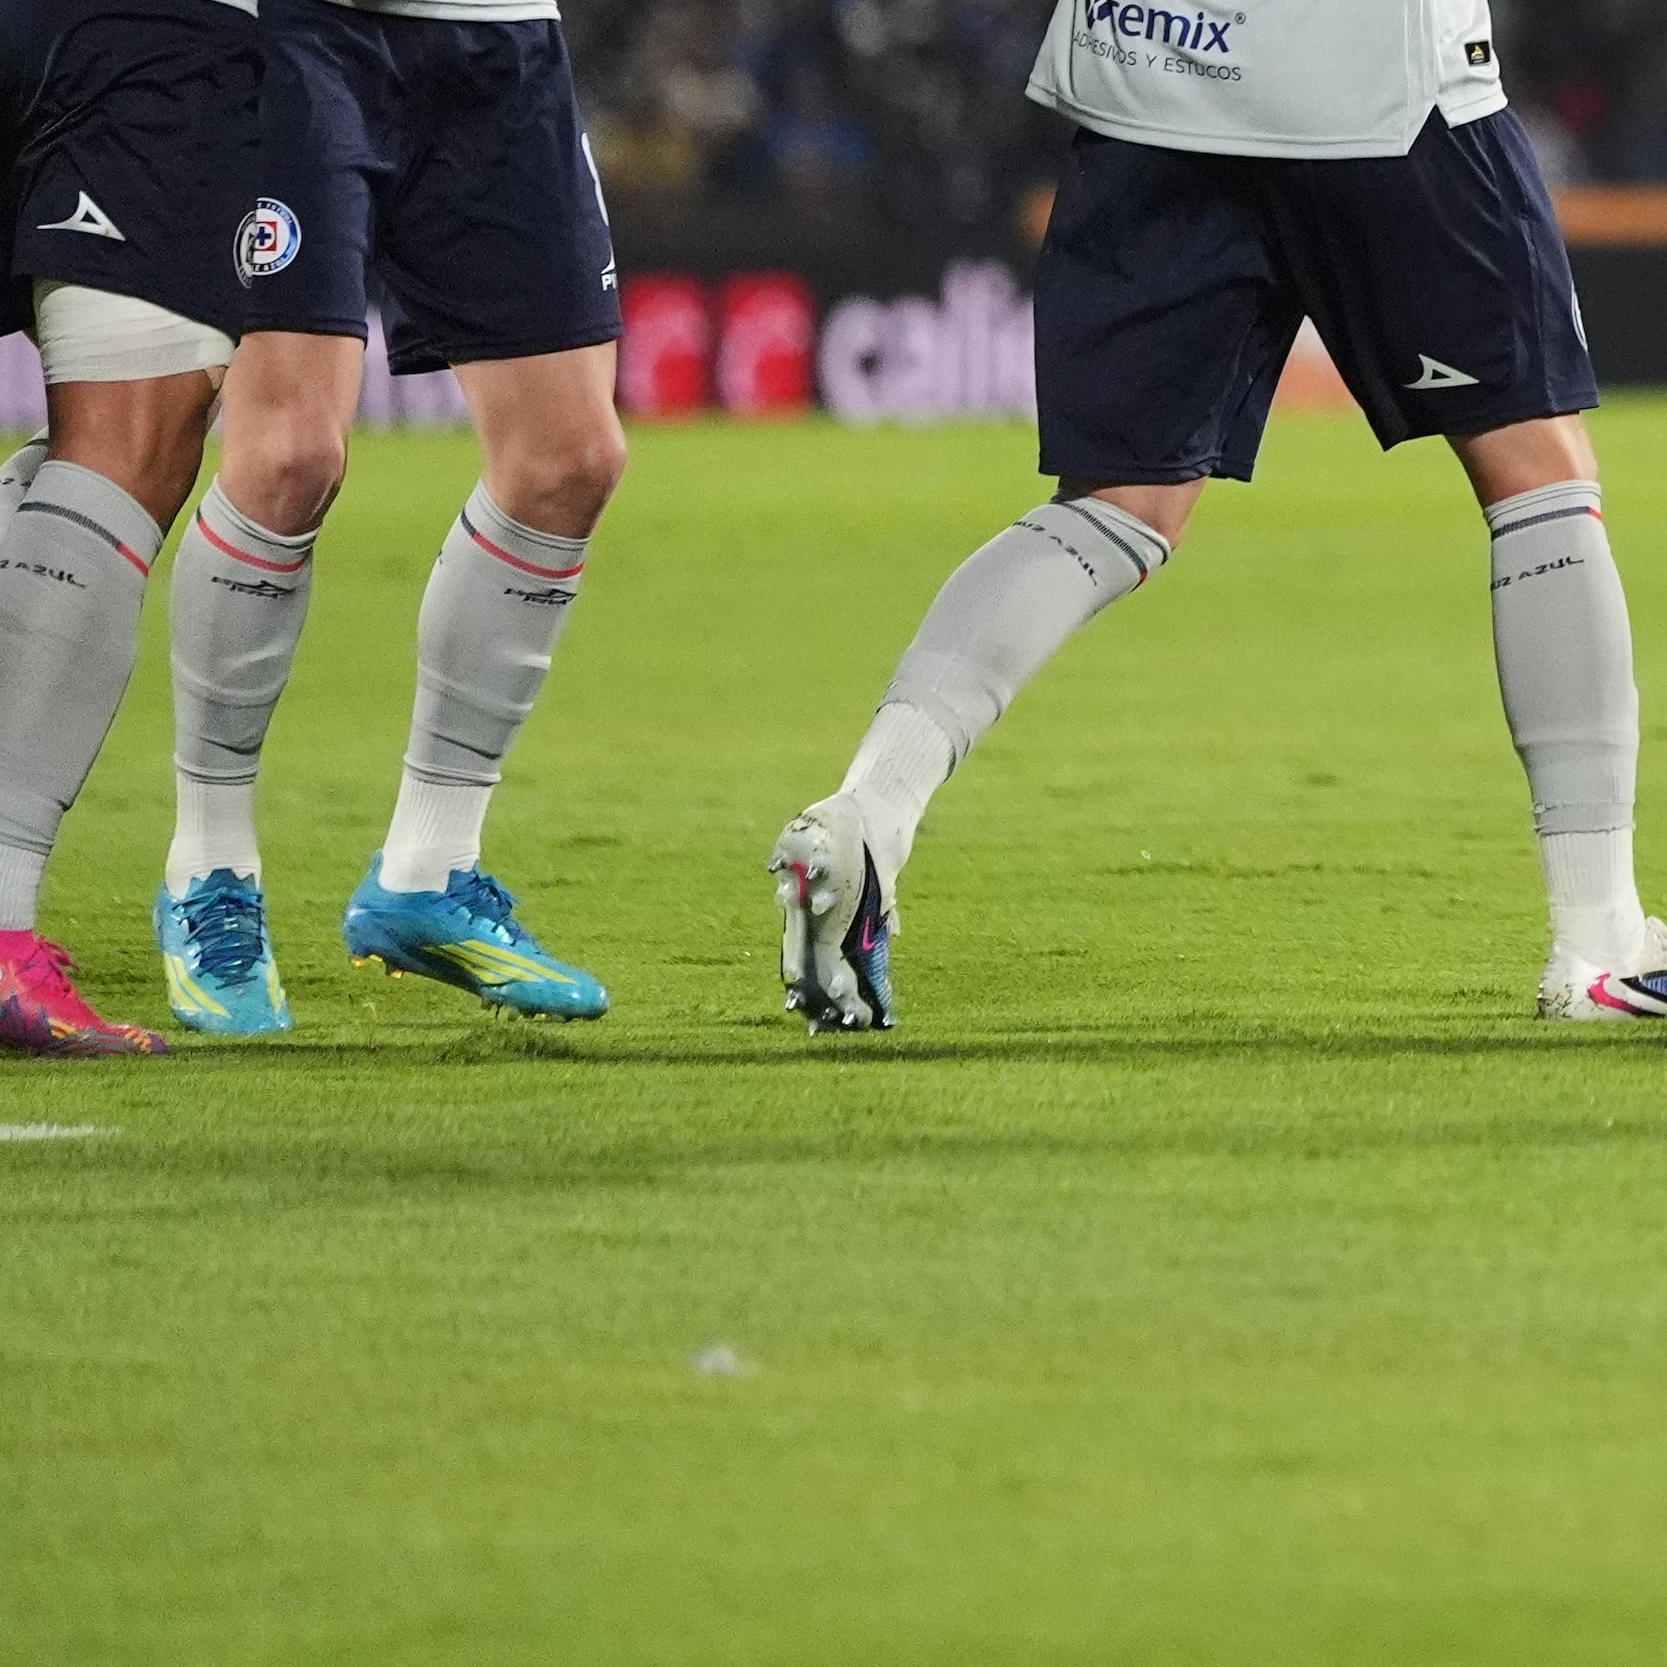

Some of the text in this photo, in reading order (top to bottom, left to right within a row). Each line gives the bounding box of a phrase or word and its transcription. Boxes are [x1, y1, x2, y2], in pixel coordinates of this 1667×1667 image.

[1145, 54, 1158, 68] Y
[1163, 57, 1243, 82] ESTUCOS
[1518, 556, 1584, 581] AZUL
